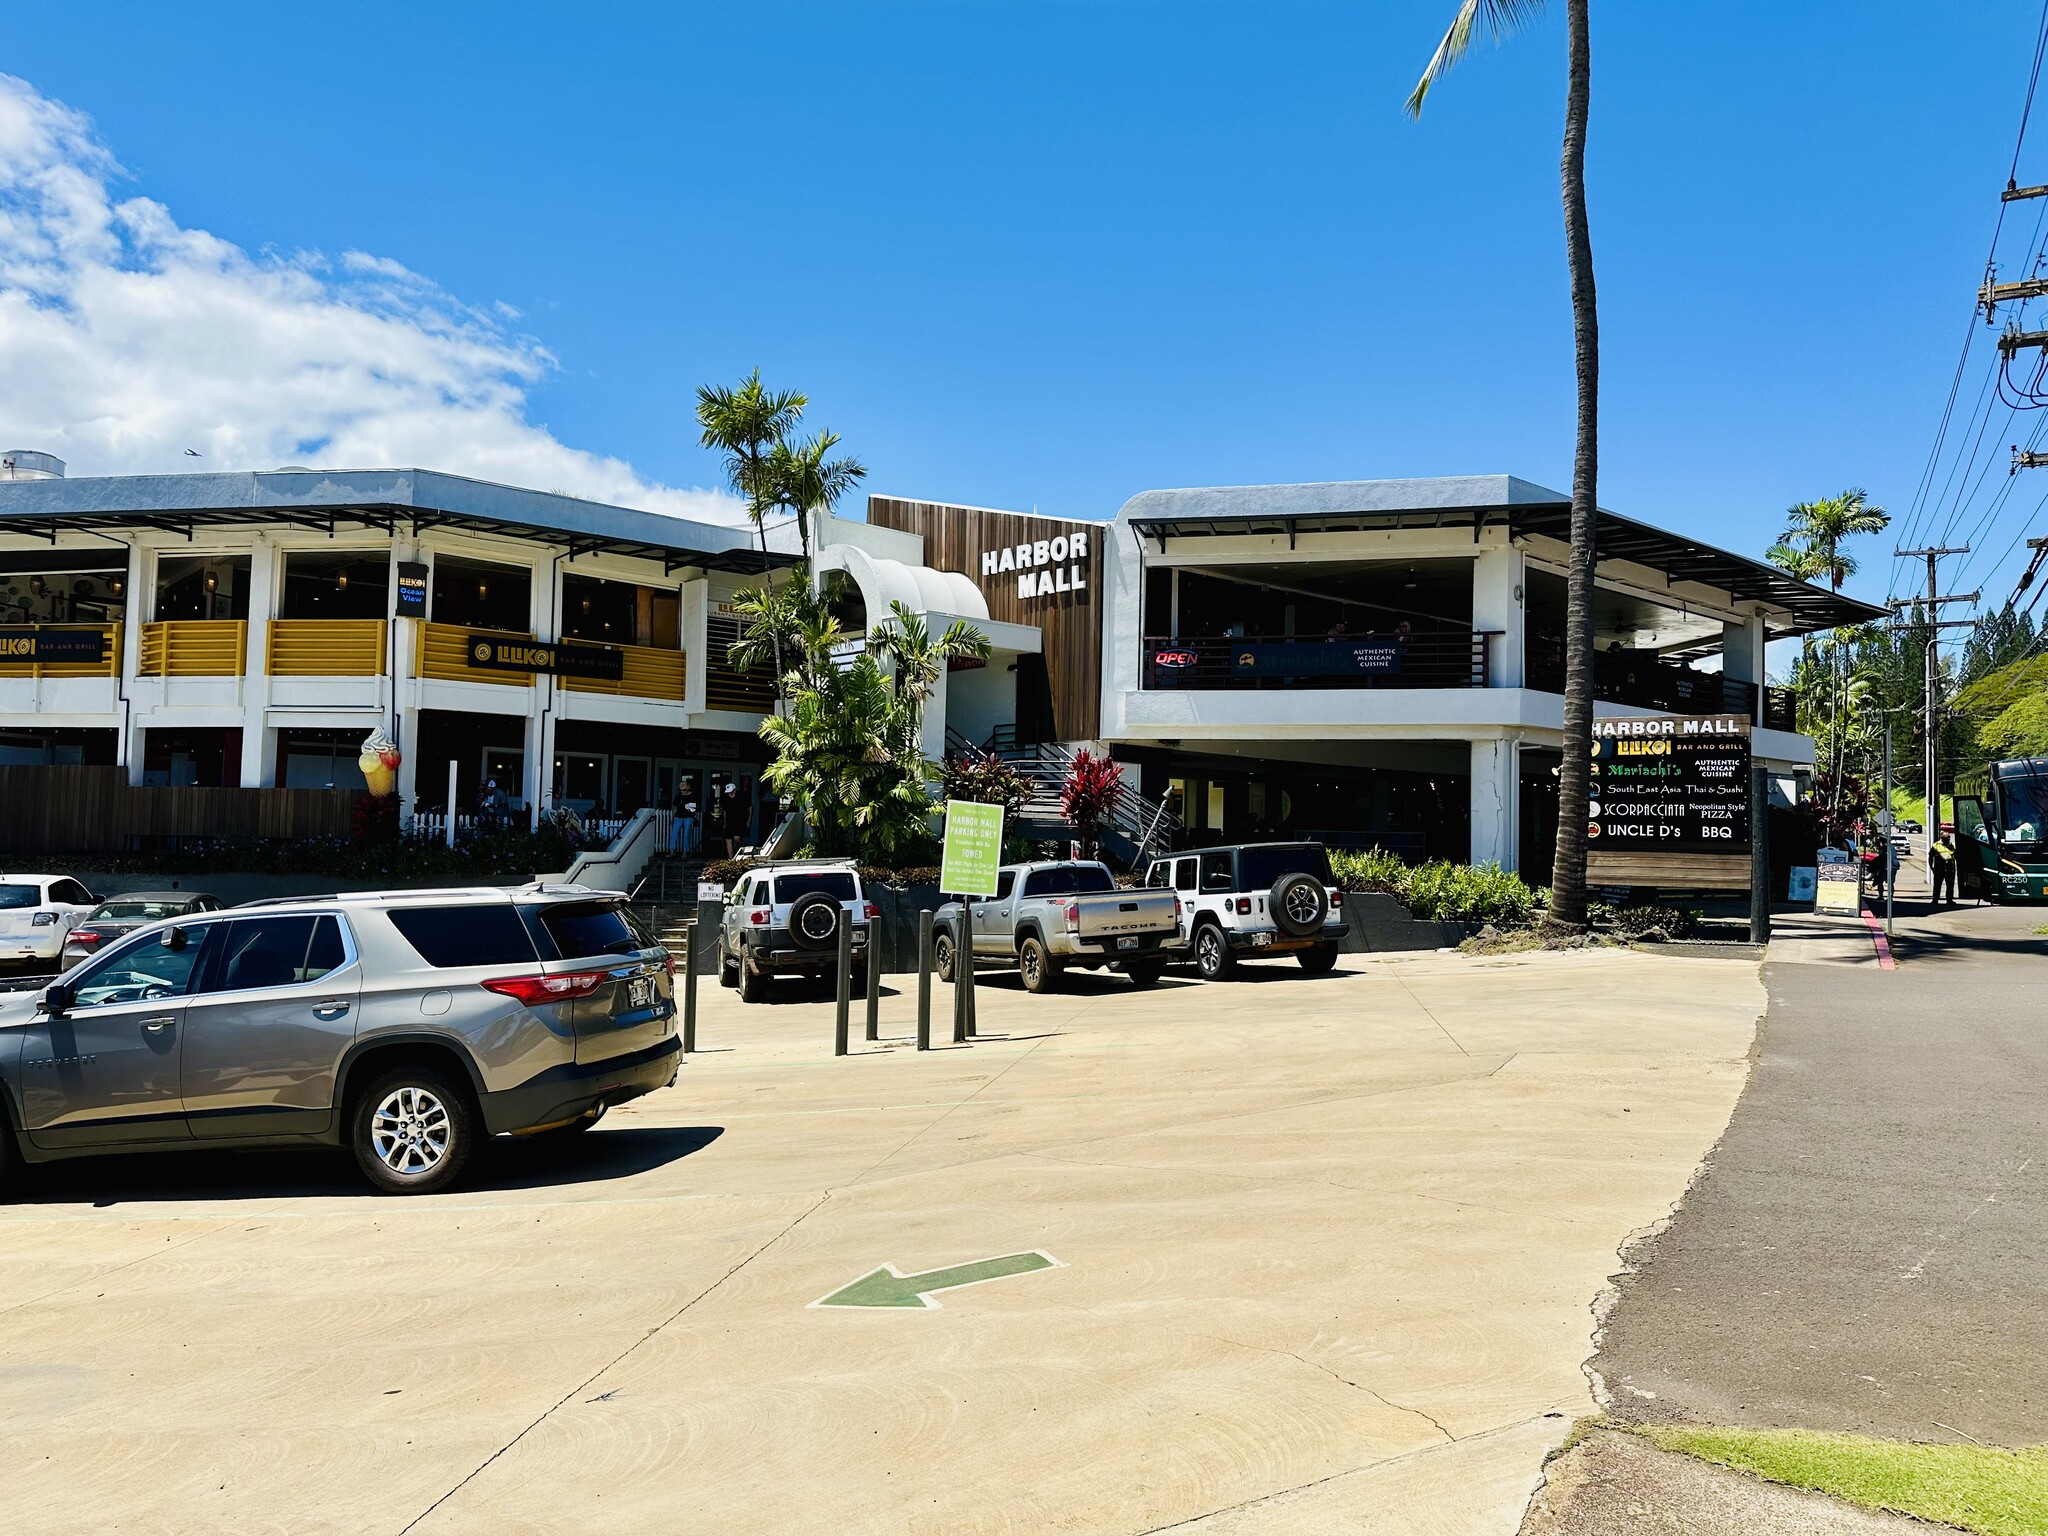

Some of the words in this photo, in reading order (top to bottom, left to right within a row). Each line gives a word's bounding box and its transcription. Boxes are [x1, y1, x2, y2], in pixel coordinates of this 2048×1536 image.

[982, 532, 1088, 576] HARBOR
[1018, 565, 1086, 599] MALL
[400, 588, 424, 596] Ocean
[498, 646, 554, 667] LILIKOI
[579, 658, 594, 666] AND
[1156, 653, 1198, 664] OPEN
[1592, 721, 1674, 736] HARBOR
[1683, 720, 1740, 734] MALL
[1618, 740, 1671, 755] LILIKOI
[1608, 761, 1682, 776] Mariachi's
[1607, 785, 1635, 794] South
[1637, 785, 1658, 794] East
[1660, 785, 1681, 794] Asia
[1685, 785, 1706, 794] Thai
[1717, 785, 1743, 794] Sushi
[1604, 804, 1685, 816] SCORPACCIATA
[952, 816, 978, 826] HARBOR
[980, 819, 996, 828] MALL
[950, 826, 978, 837] PARKING
[981, 830, 997, 839] ONLY
[1608, 825, 1654, 836] UNCLE
[1660, 826, 1681, 837] D's
[1702, 826, 1732, 838] BBQ
[962, 849, 982, 859] TOWED
